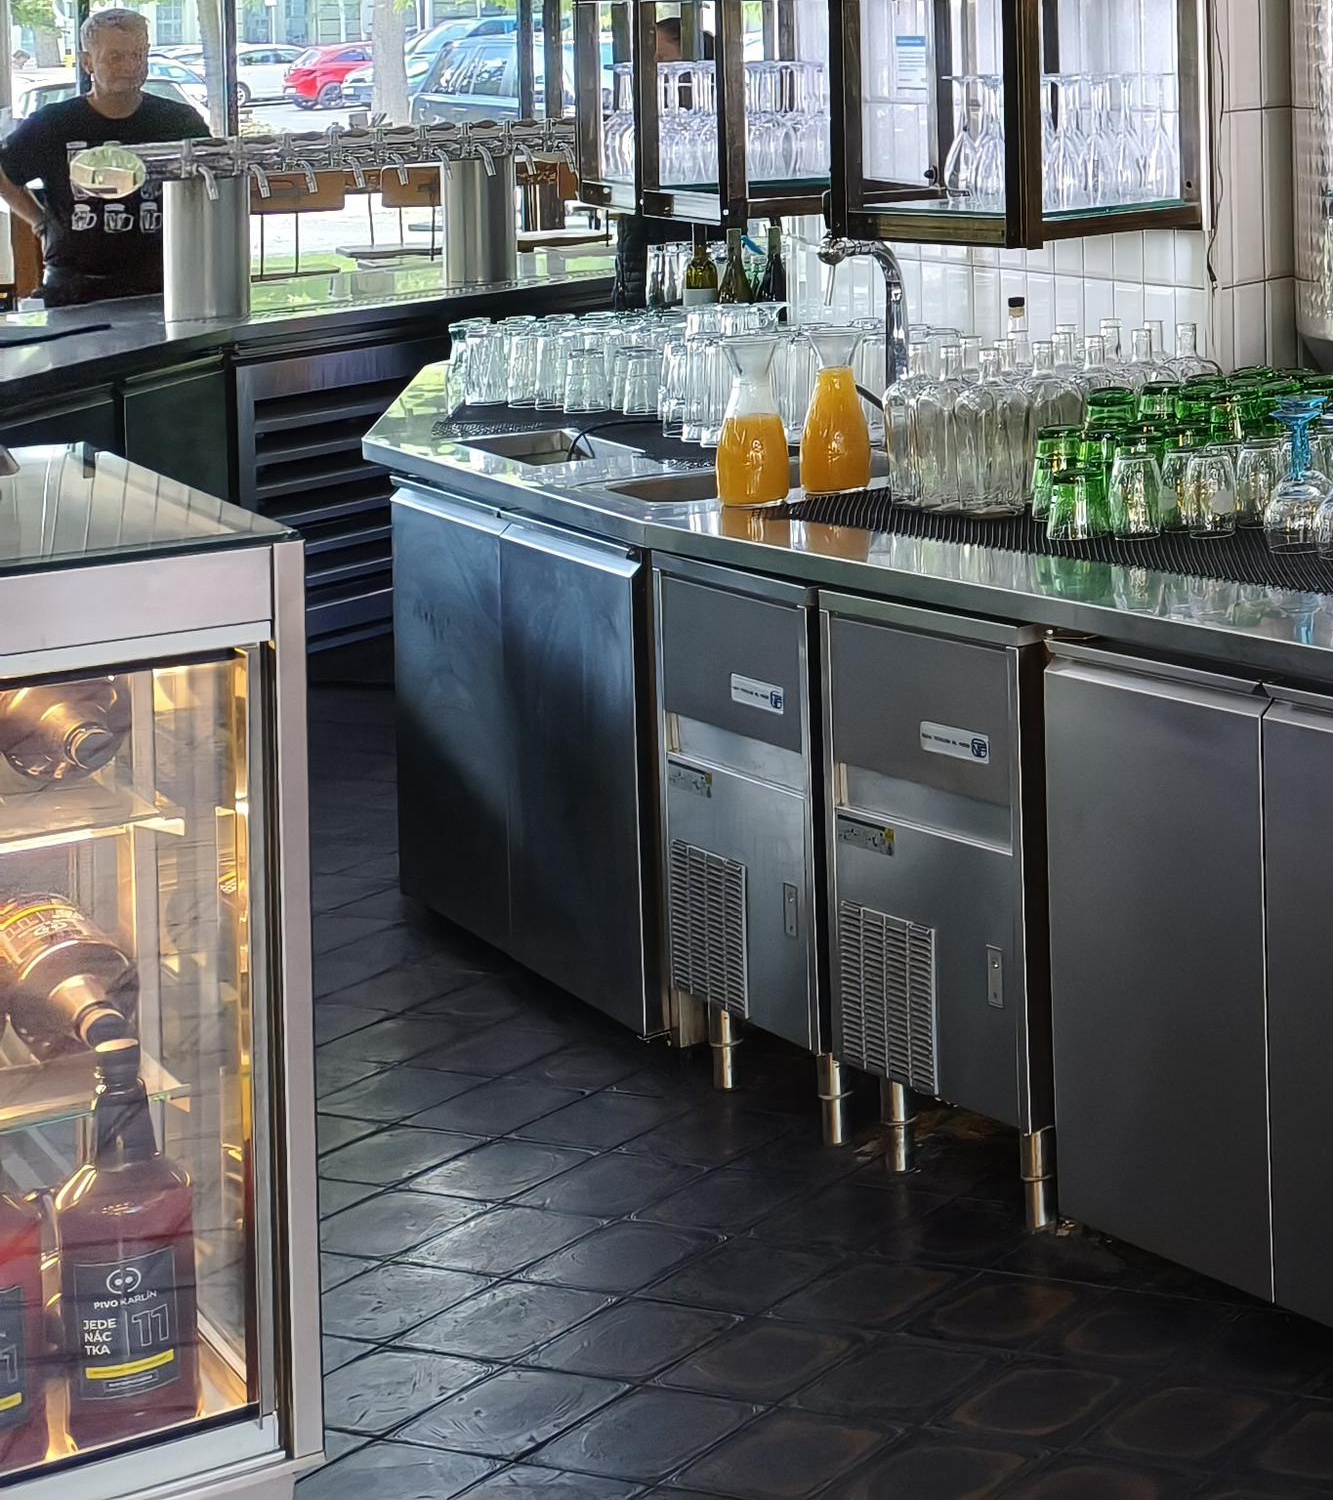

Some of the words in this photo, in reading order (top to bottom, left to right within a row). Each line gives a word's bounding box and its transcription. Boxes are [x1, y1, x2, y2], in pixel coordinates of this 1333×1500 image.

[93, 1300, 119, 1310] PIVO
[120, 1290, 157, 1307] KARLÍN
[83, 1318, 117, 1331] JEDE
[131, 1303, 170, 1347] 11
[84, 1329, 112, 1342] NÁC
[85, 1344, 111, 1356] TKA
